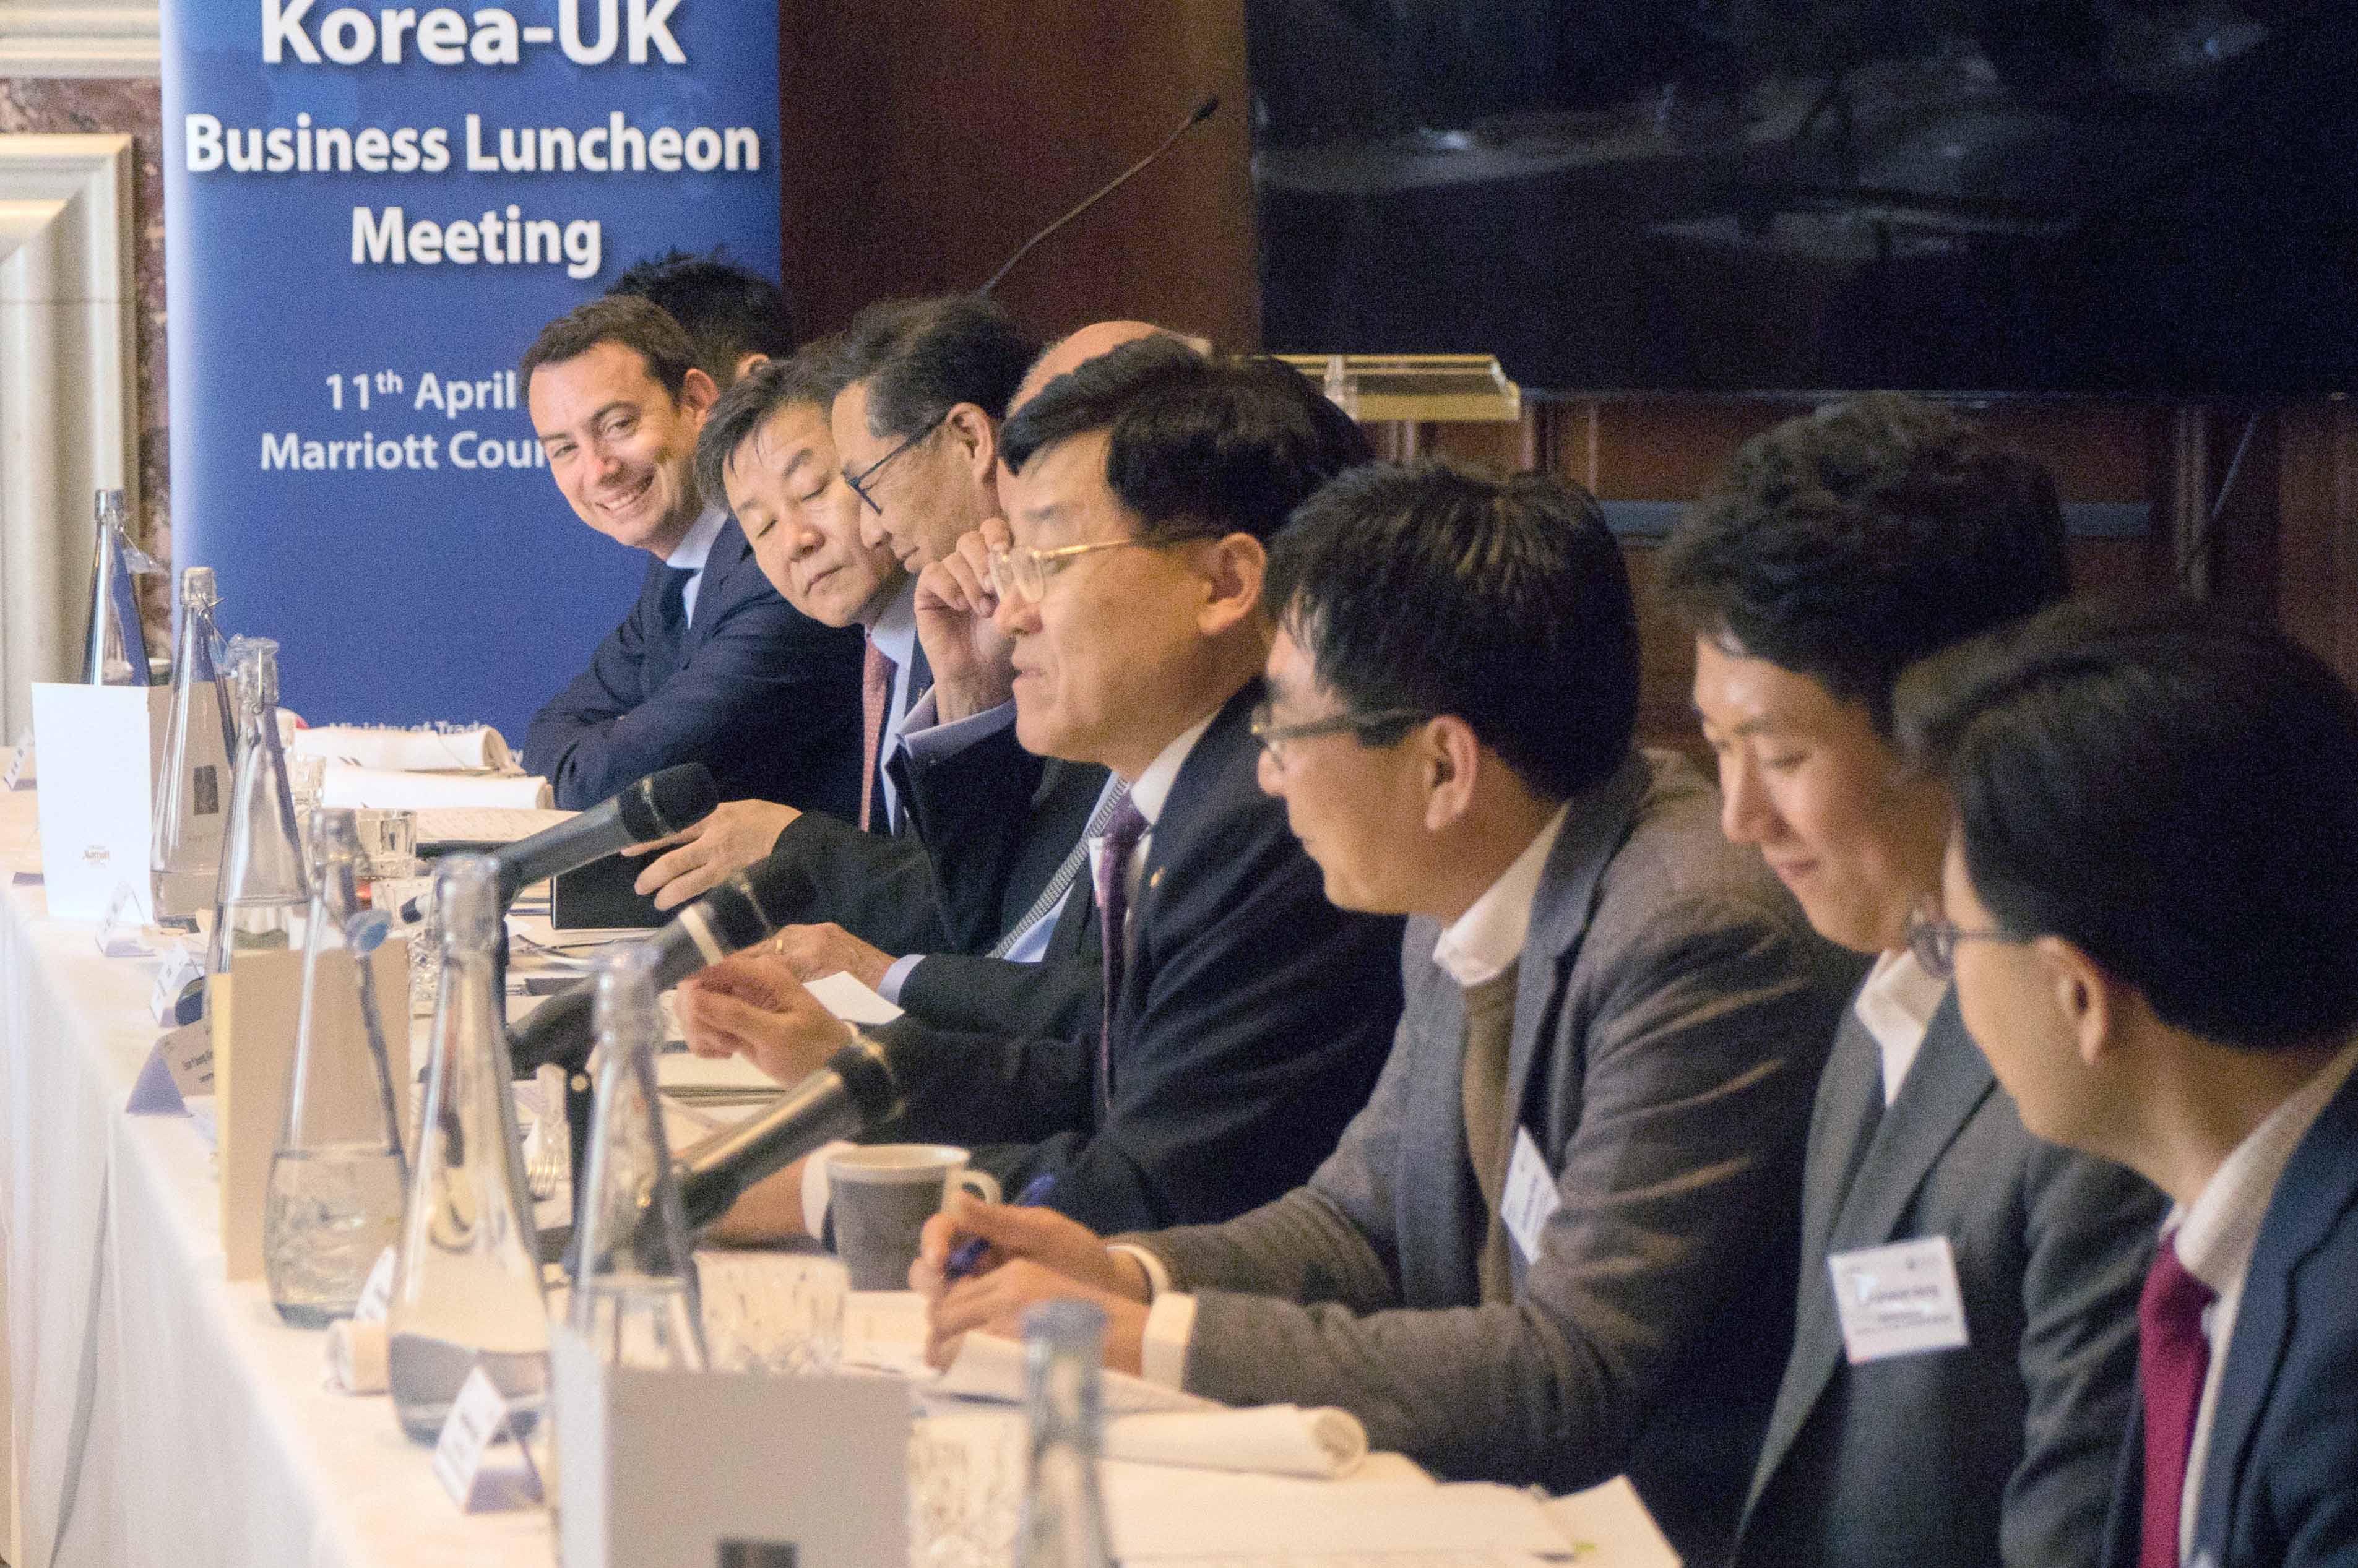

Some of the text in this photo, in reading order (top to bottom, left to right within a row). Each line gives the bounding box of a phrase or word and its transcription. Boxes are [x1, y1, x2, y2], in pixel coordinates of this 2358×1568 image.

[261, 0, 687, 65] Korea-UK
[185, 111, 760, 173] Business Luncheon
[351, 204, 602, 279] Meeting
[326, 369, 517, 419] 11th April
[260, 431, 439, 470] Marriott
